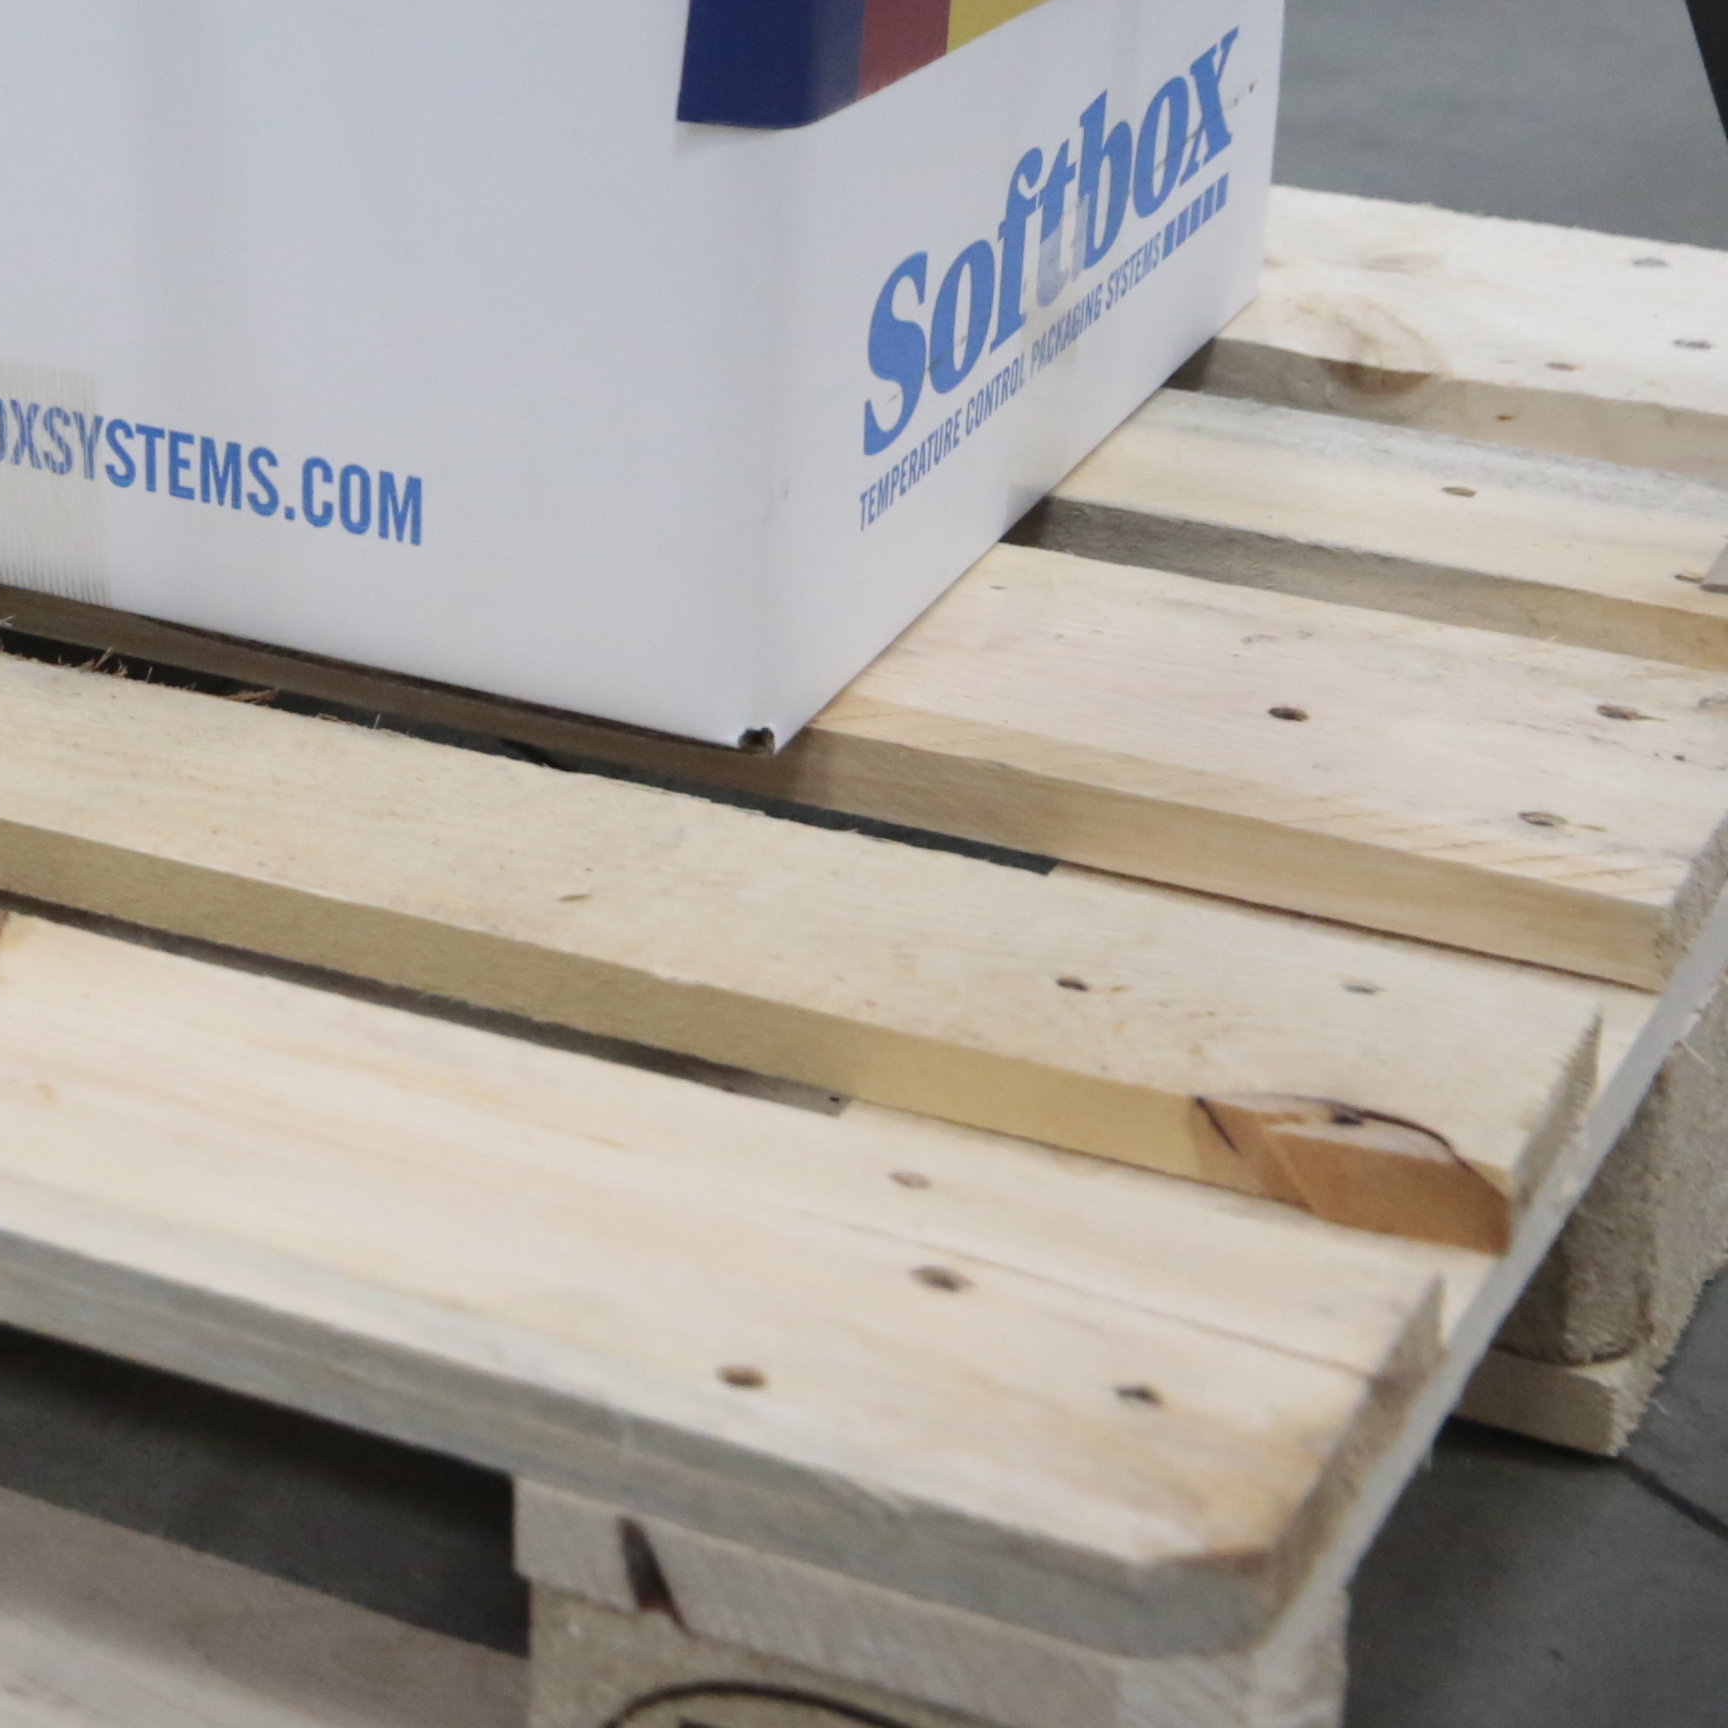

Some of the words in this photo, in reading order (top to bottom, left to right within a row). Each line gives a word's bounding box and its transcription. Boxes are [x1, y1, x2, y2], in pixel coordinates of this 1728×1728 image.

[863, 25, 1240, 457] Softbox
[859, 407, 962, 533] TEMPERATURE
[964, 351, 1026, 437] CONTROL
